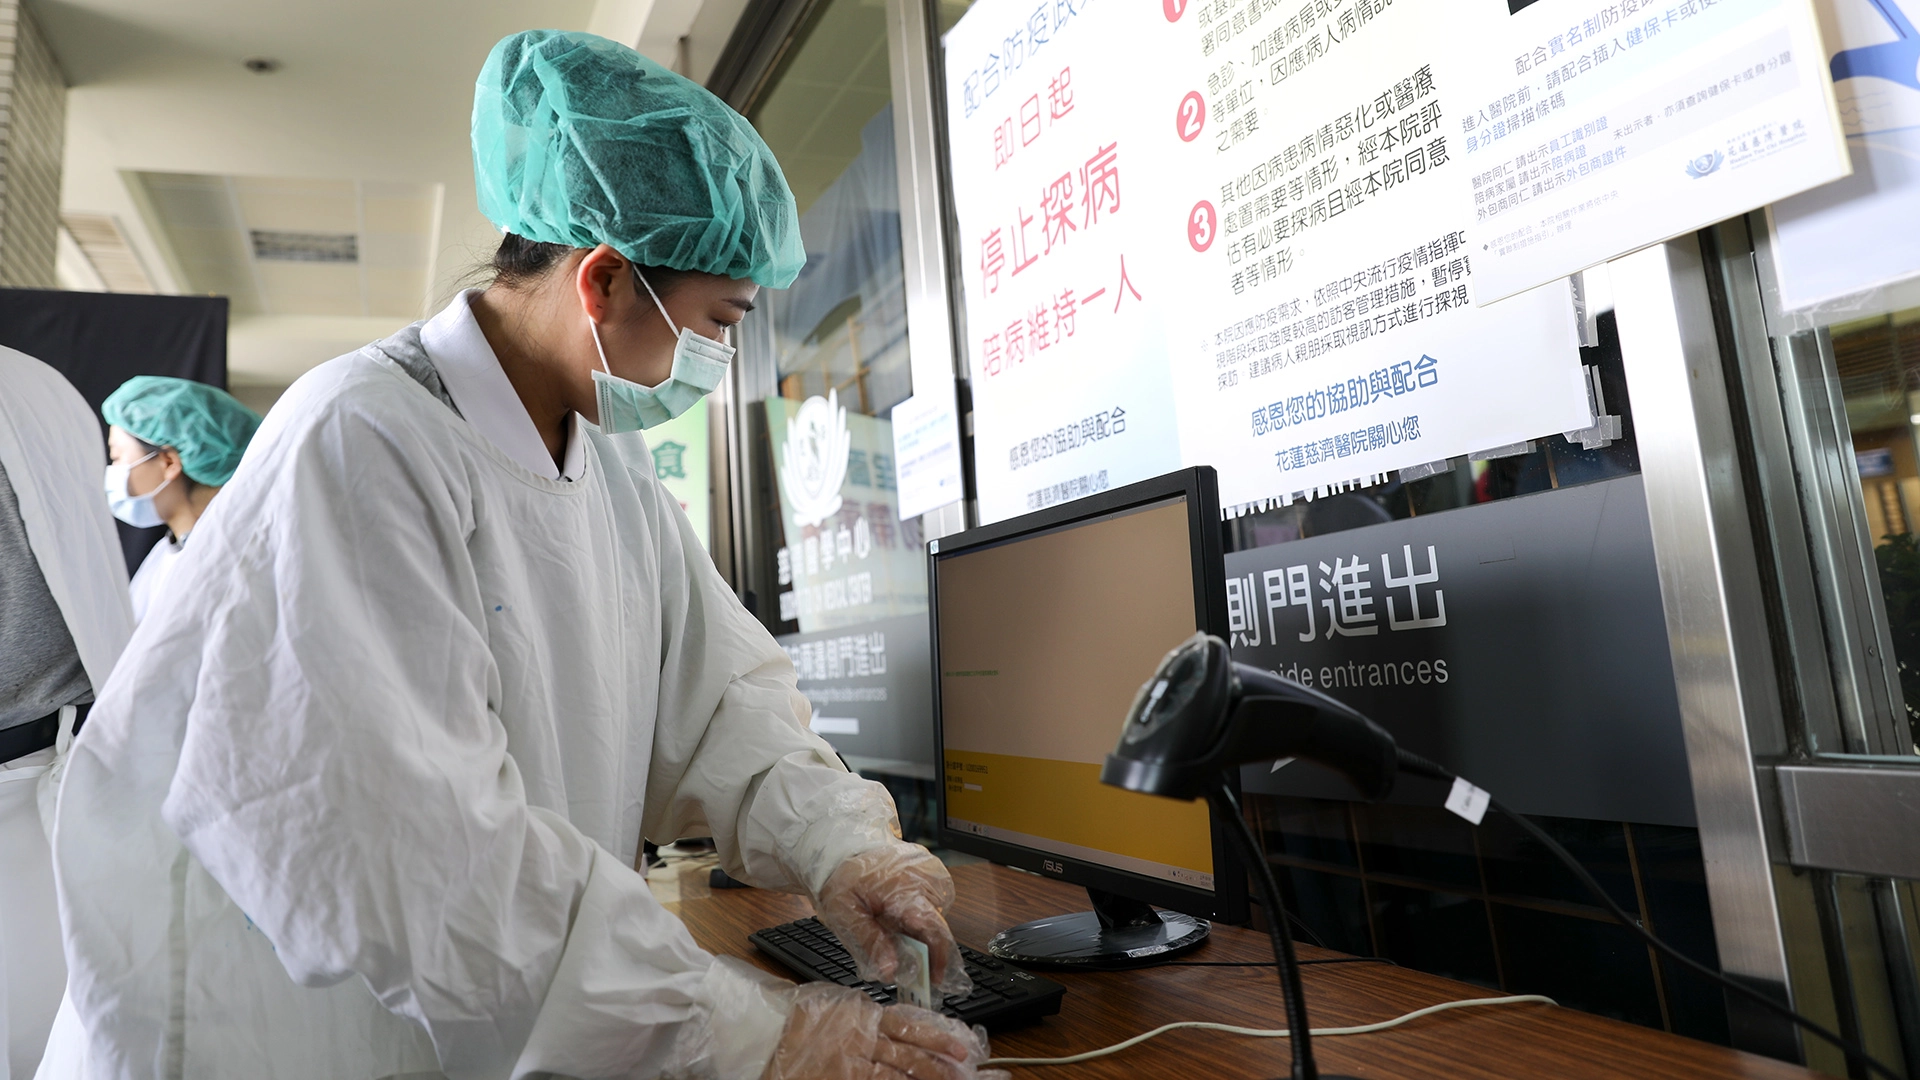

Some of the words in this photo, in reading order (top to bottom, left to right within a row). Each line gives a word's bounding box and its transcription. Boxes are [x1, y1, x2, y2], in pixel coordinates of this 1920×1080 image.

[1197, 0, 1237, 29] 或基
[1201, 0, 1281, 57] 署同意書
[1207, 0, 1341, 98] 急診、加護病房或
[1514, 0, 1655, 76] 配合實名制防疫
[963, 0, 1094, 119] 配合防疫政
[993, 66, 1075, 171] 即日起
[1220, 64, 1437, 208] 其他因病患病情惡化或醫療
[1465, 90, 1567, 154] 身分證掃描條碼
[1471, 161, 1514, 190] 醫院同仁
[1515, 116, 1608, 170] 請出示員工識別證
[1223, 99, 1443, 238] 處置需要等情形，經本院評
[1226, 136, 1451, 267] 估有必要探病且經本院同意
[1474, 176, 1517, 206] 陪病家屬
[1518, 144, 1587, 186] 請出示陪病證
[1476, 188, 1530, 222] 外包商同仁
[1532, 145, 1627, 197] 請出示外包商證件
[980, 141, 1121, 299] 停止探病
[982, 253, 1142, 383] 陪病維持一人
[1250, 353, 1439, 438] 感恩您的協助與配合
[1008, 405, 1126, 471] 感恩您的協助與配合
[1274, 415, 1422, 474] 花蓮慈濟醫院關心您
[1319, 656, 1450, 690] entrances
[1042, 859, 1064, 874] ASUS
